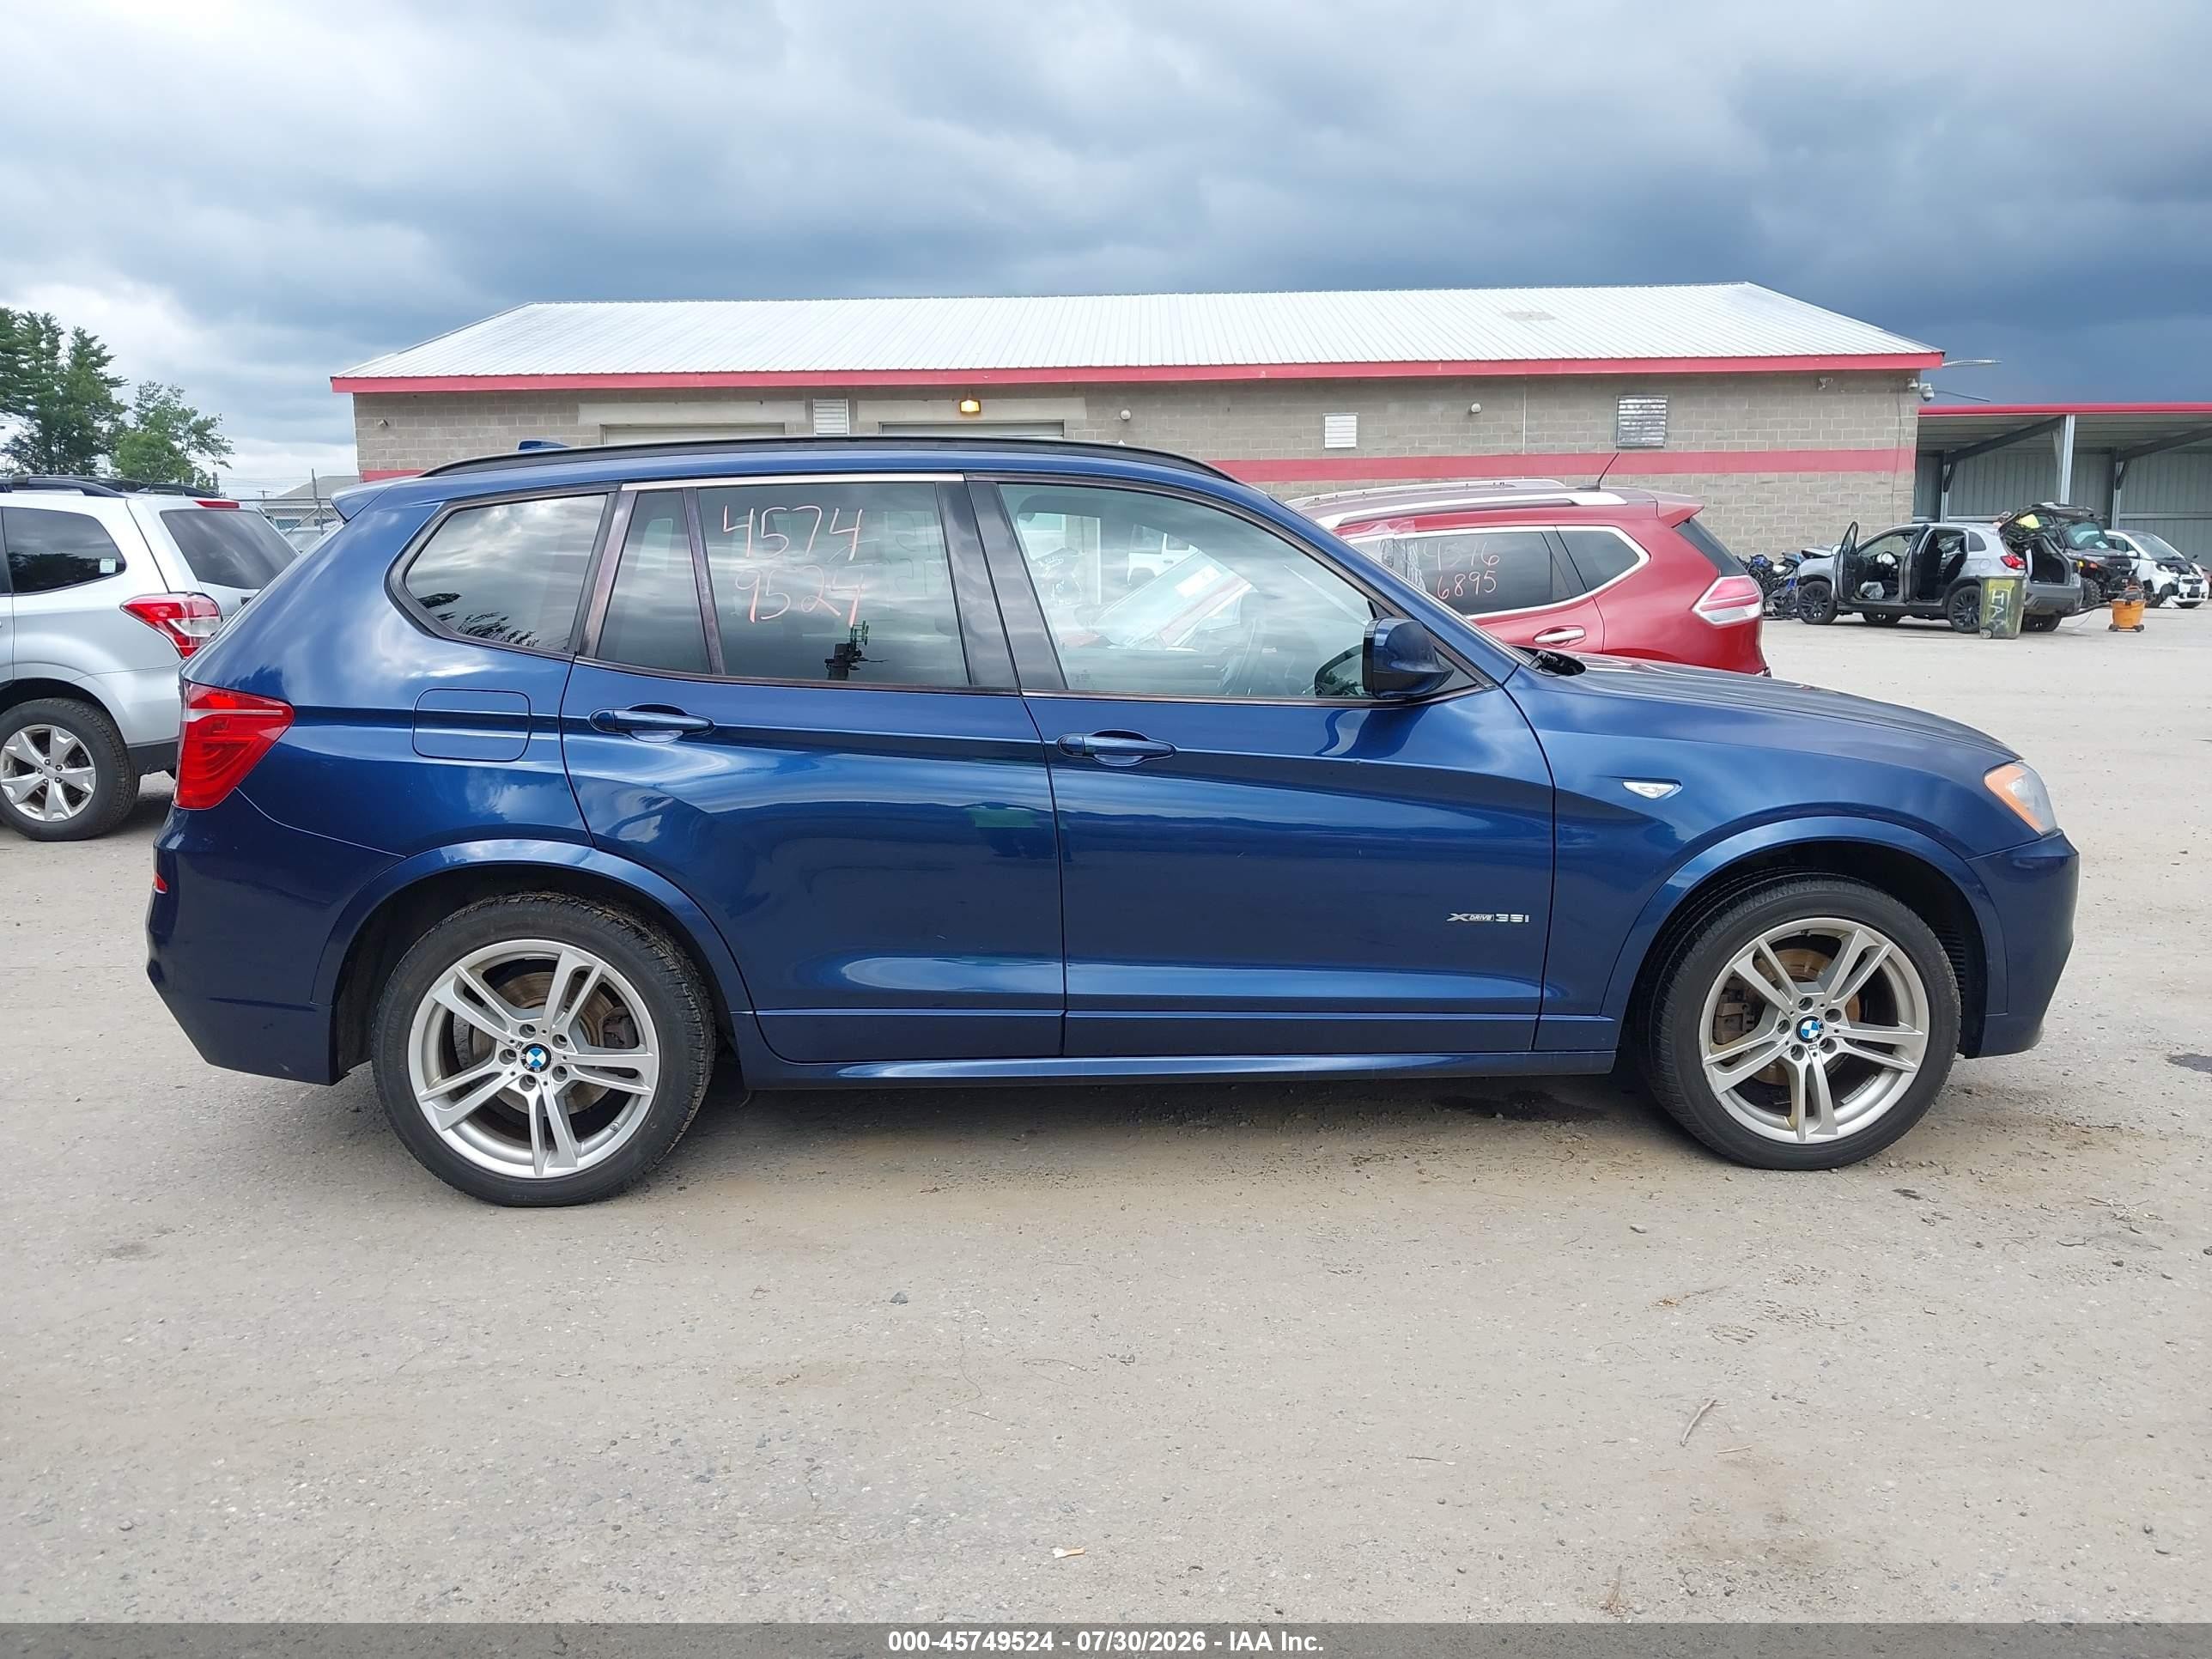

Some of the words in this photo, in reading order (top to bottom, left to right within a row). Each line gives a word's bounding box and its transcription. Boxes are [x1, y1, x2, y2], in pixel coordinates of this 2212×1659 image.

[723, 505, 863, 561] 4574
[735, 564, 866, 628] 9524
[1437, 570, 1497, 599] 6895
